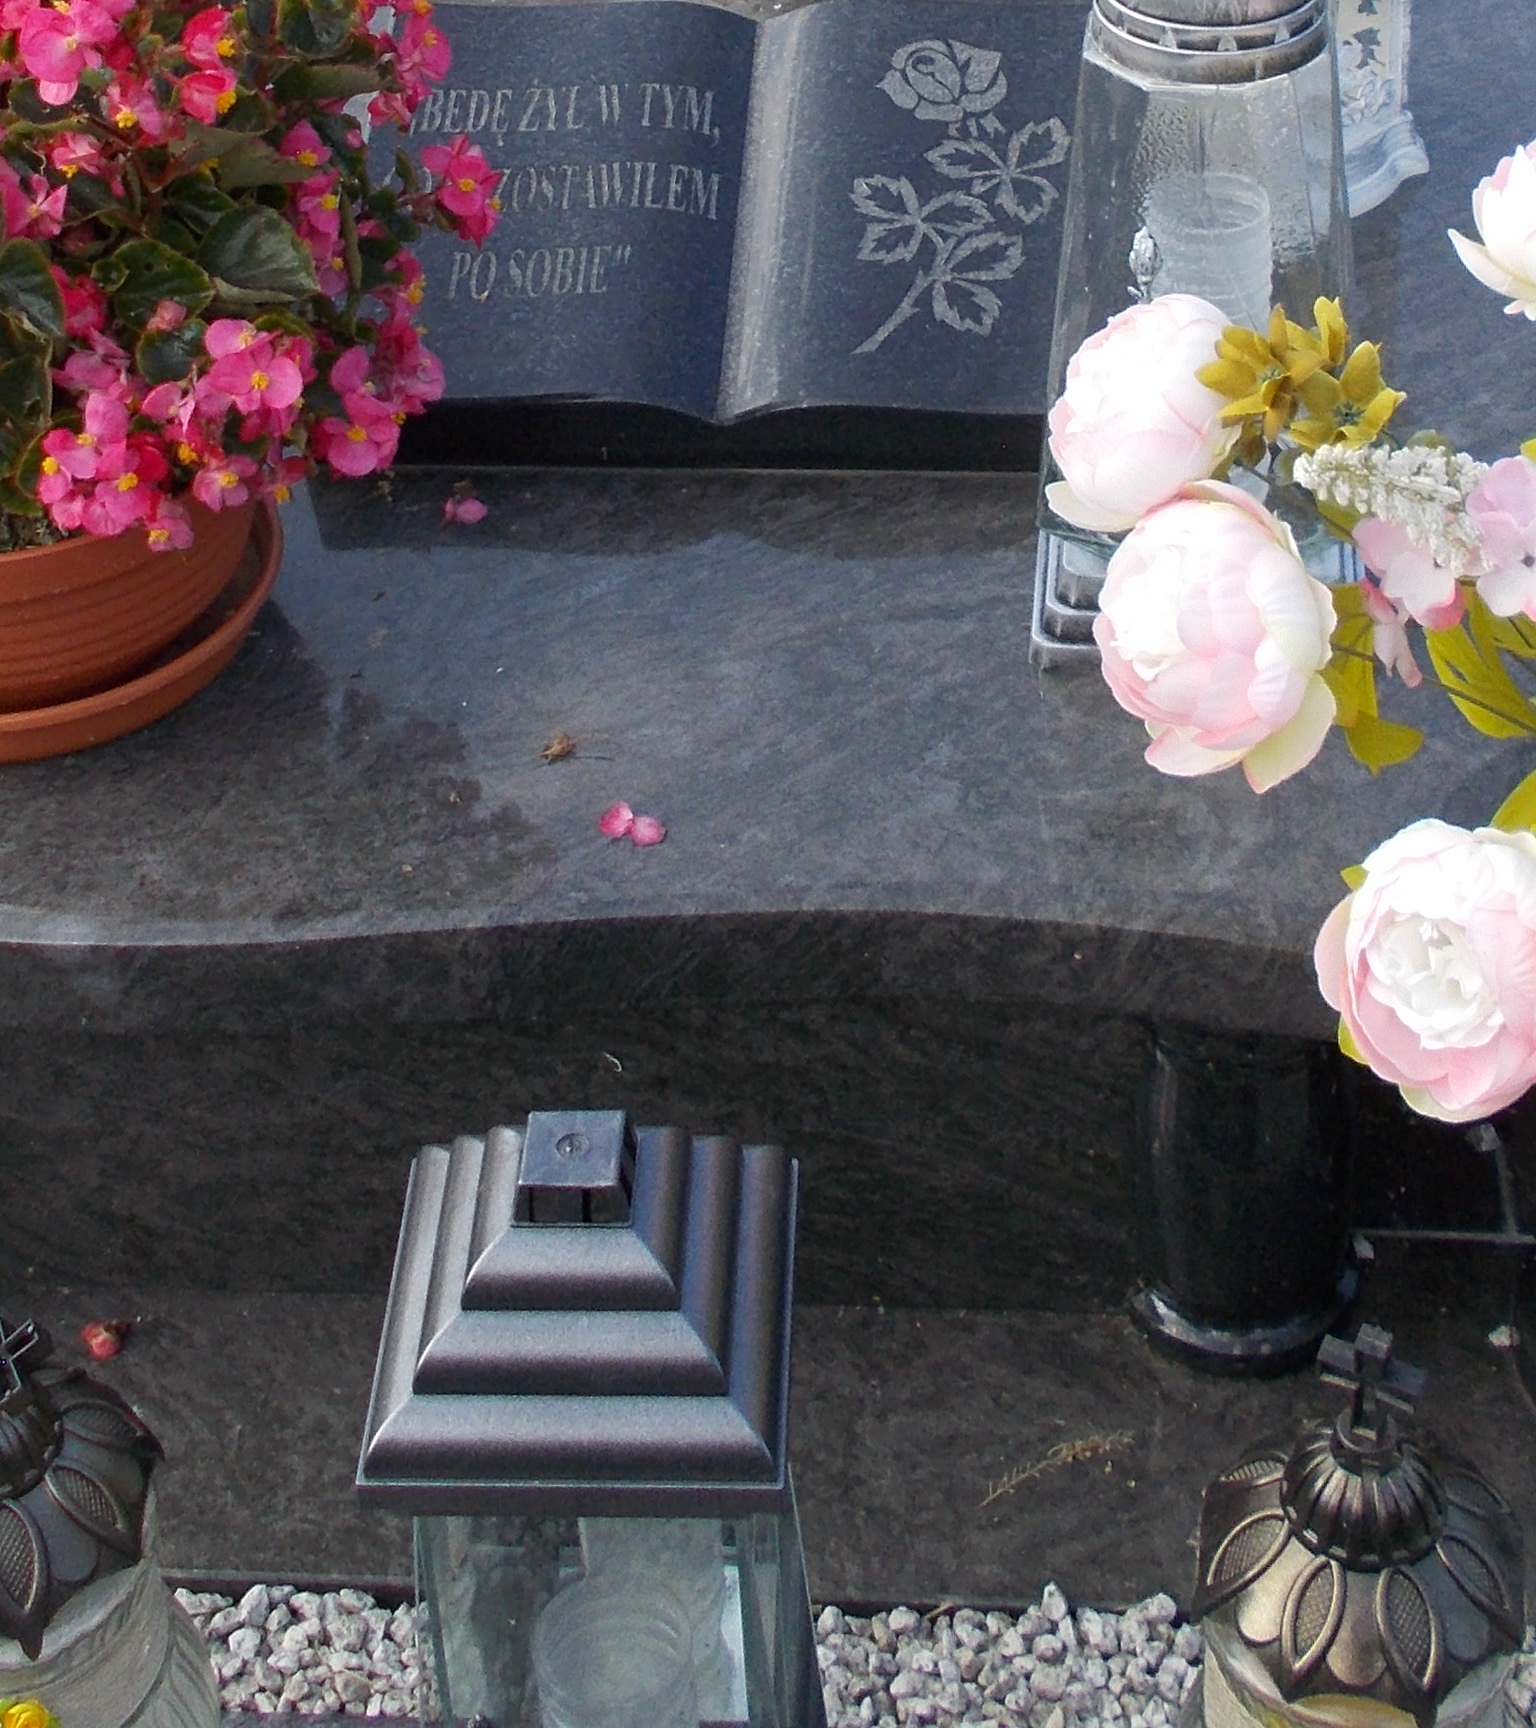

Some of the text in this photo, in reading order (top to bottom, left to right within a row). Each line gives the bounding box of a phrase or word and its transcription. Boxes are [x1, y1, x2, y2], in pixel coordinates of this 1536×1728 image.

[597, 82, 630, 128] W
[640, 82, 721, 148] TYM,
[443, 249, 498, 300] PO
